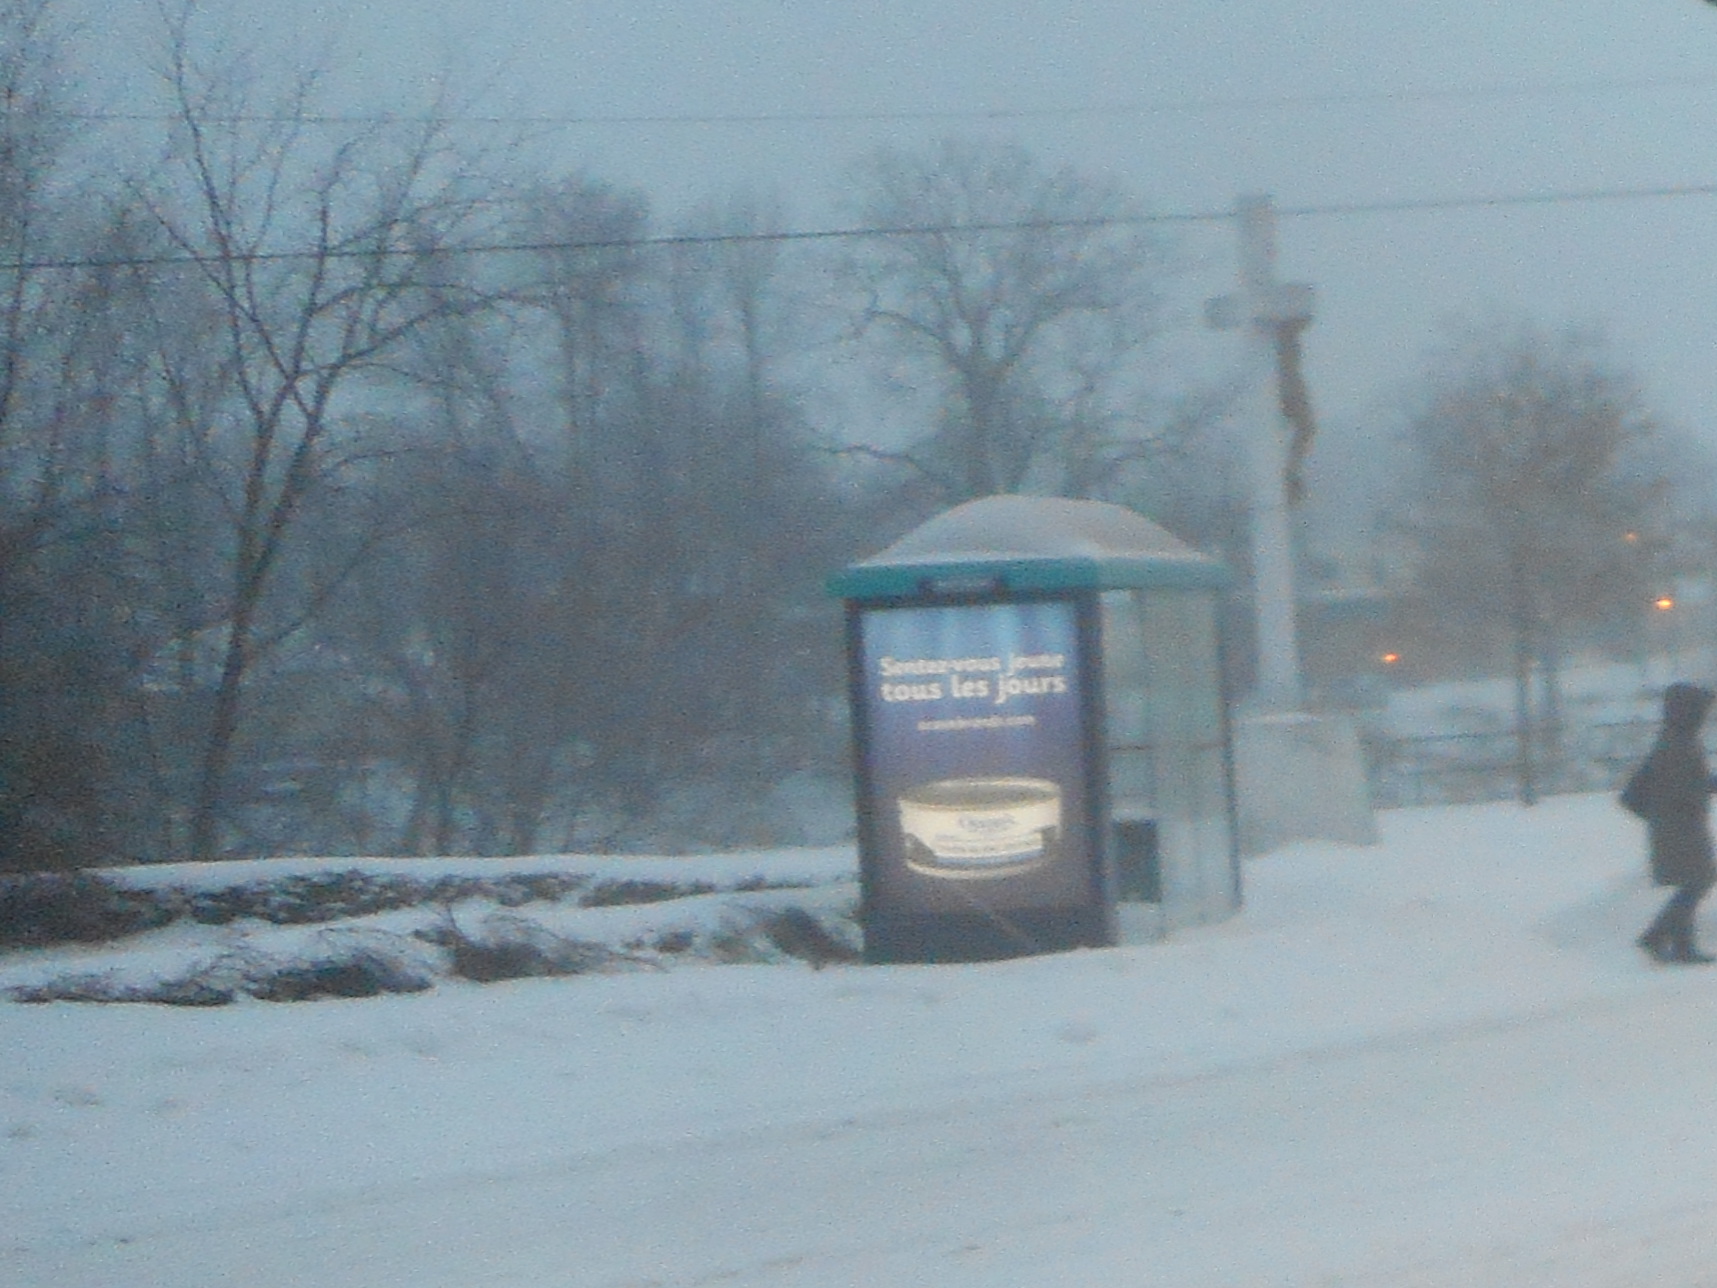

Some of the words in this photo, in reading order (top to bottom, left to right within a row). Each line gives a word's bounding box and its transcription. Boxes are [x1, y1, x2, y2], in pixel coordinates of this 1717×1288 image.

[880, 681, 942, 702] tous
[951, 674, 989, 698] les
[994, 674, 1066, 704] jours
